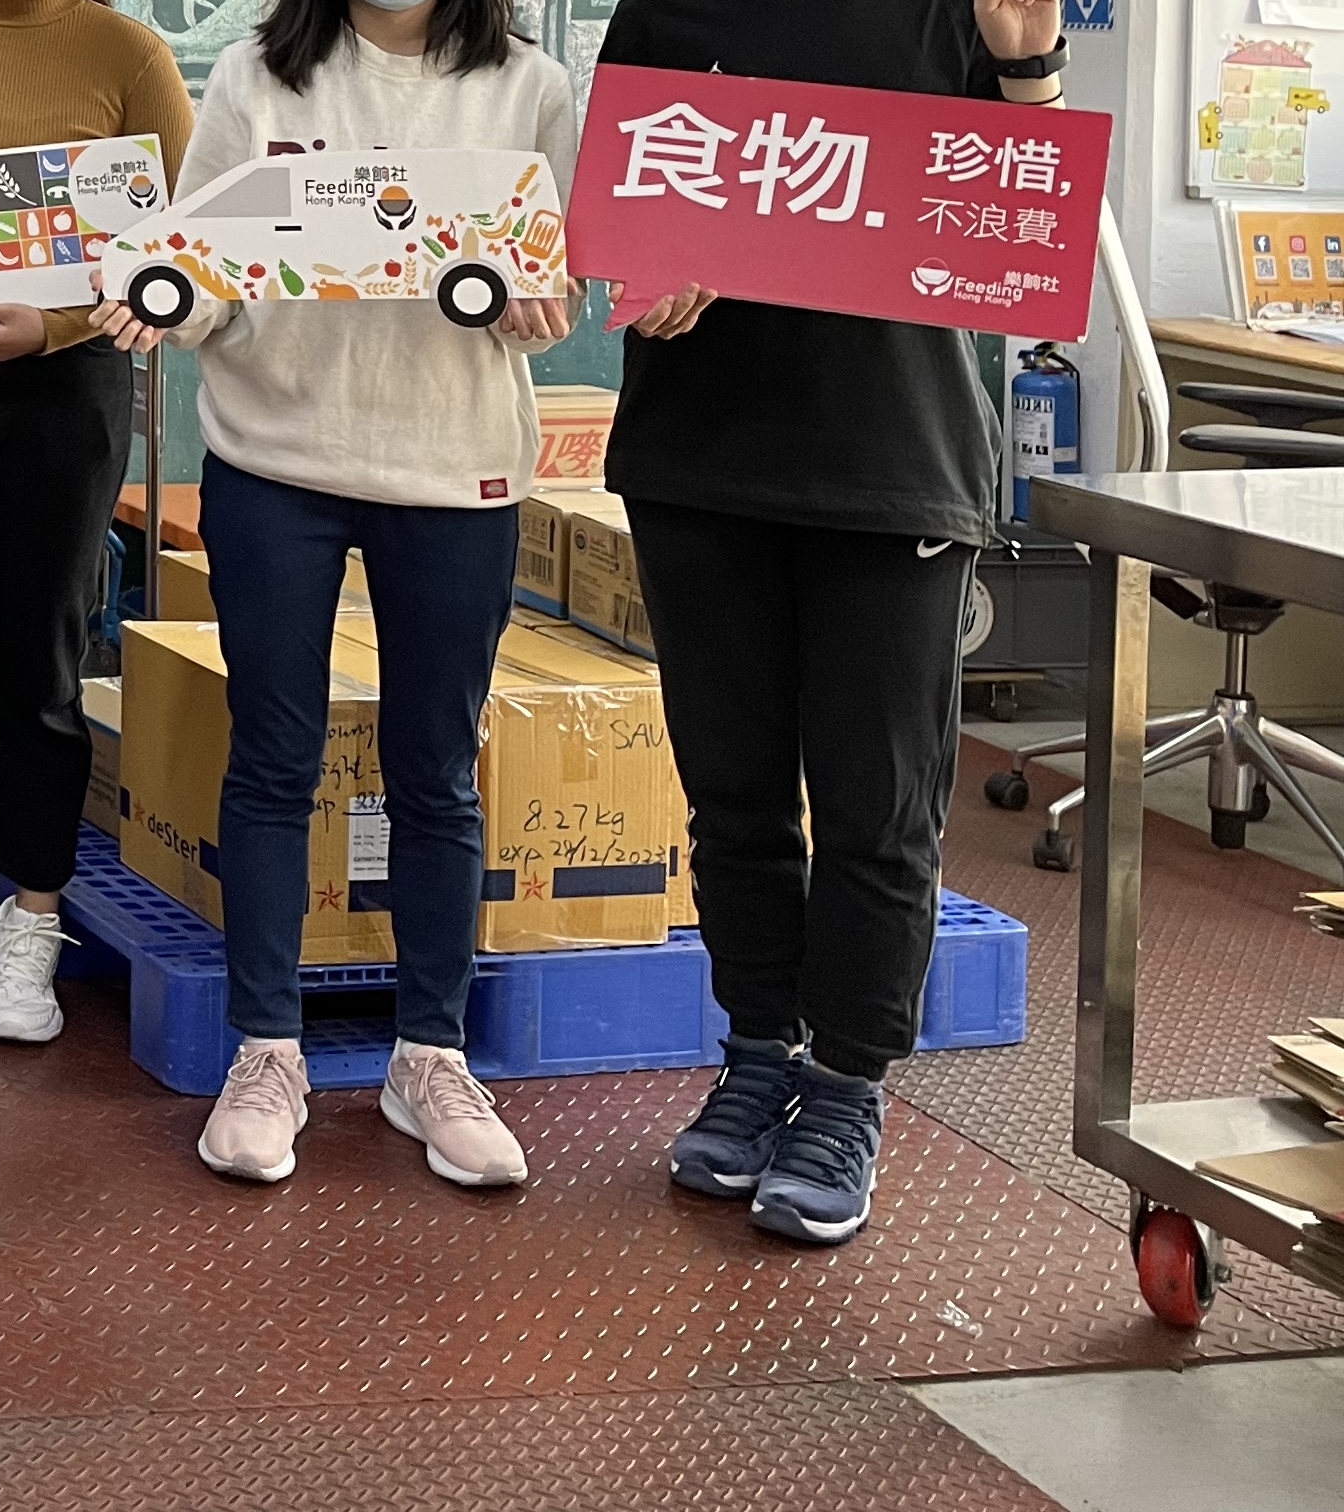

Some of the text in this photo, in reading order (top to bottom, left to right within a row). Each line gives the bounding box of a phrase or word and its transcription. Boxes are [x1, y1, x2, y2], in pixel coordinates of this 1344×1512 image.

[612, 101, 886, 229] 食物.
[925, 130, 1073, 199] 珍惜,
[75, 170, 128, 190] Feeding
[304, 178, 376, 200] Feeding
[304, 194, 366, 207] Hong Kong
[917, 196, 1066, 251] 不浪費.
[953, 289, 1013, 309] Hong Kong
[954, 275, 1024, 304] Feeding
[147, 811, 198, 863] deSter
[498, 844, 545, 876] exp
